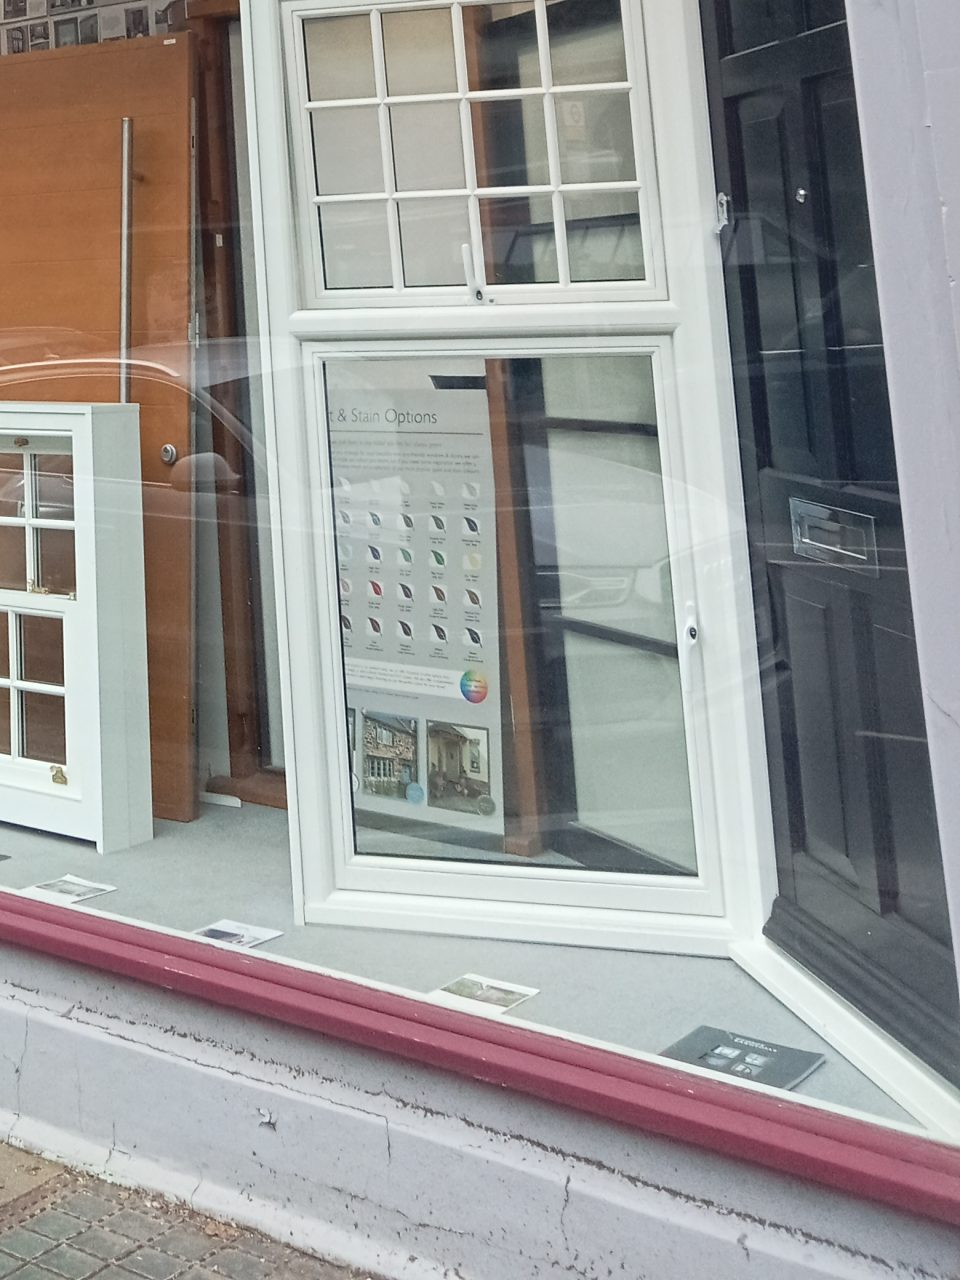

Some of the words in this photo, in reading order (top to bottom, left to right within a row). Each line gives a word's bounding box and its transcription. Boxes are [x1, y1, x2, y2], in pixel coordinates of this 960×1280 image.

[337, 408, 346, 422] &
[351, 408, 380, 424] Stain
[385, 408, 438, 427] Options
